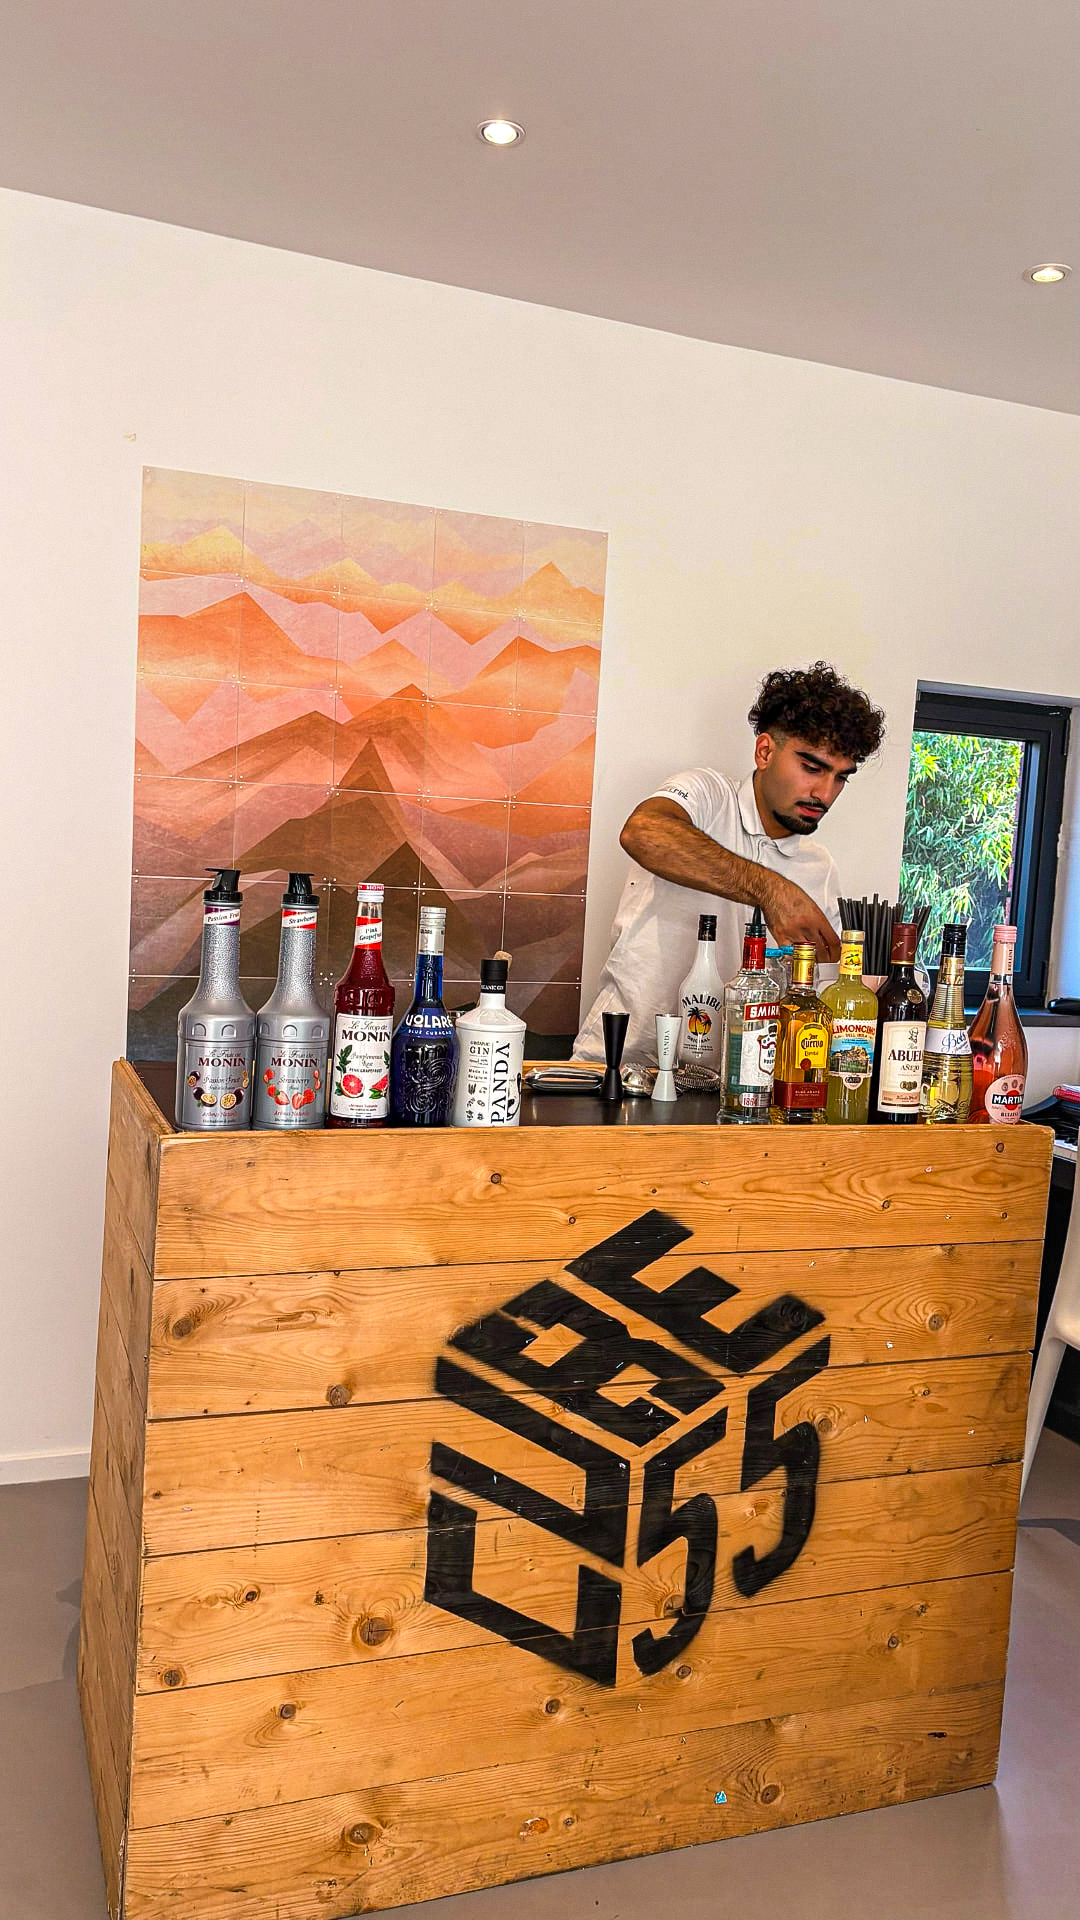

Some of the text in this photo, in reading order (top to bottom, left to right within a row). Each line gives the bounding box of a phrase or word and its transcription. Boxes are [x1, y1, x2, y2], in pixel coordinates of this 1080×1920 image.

[682, 994, 722, 1012] MALIBU
[341, 1029, 391, 1042] MONIN
[800, 1037, 823, 1050] Cuervo
[469, 1046, 489, 1055] GIN
[198, 1057, 246, 1067] MONIN
[271, 1057, 318, 1067] MONIN
[490, 1042, 511, 1124] PANDA
